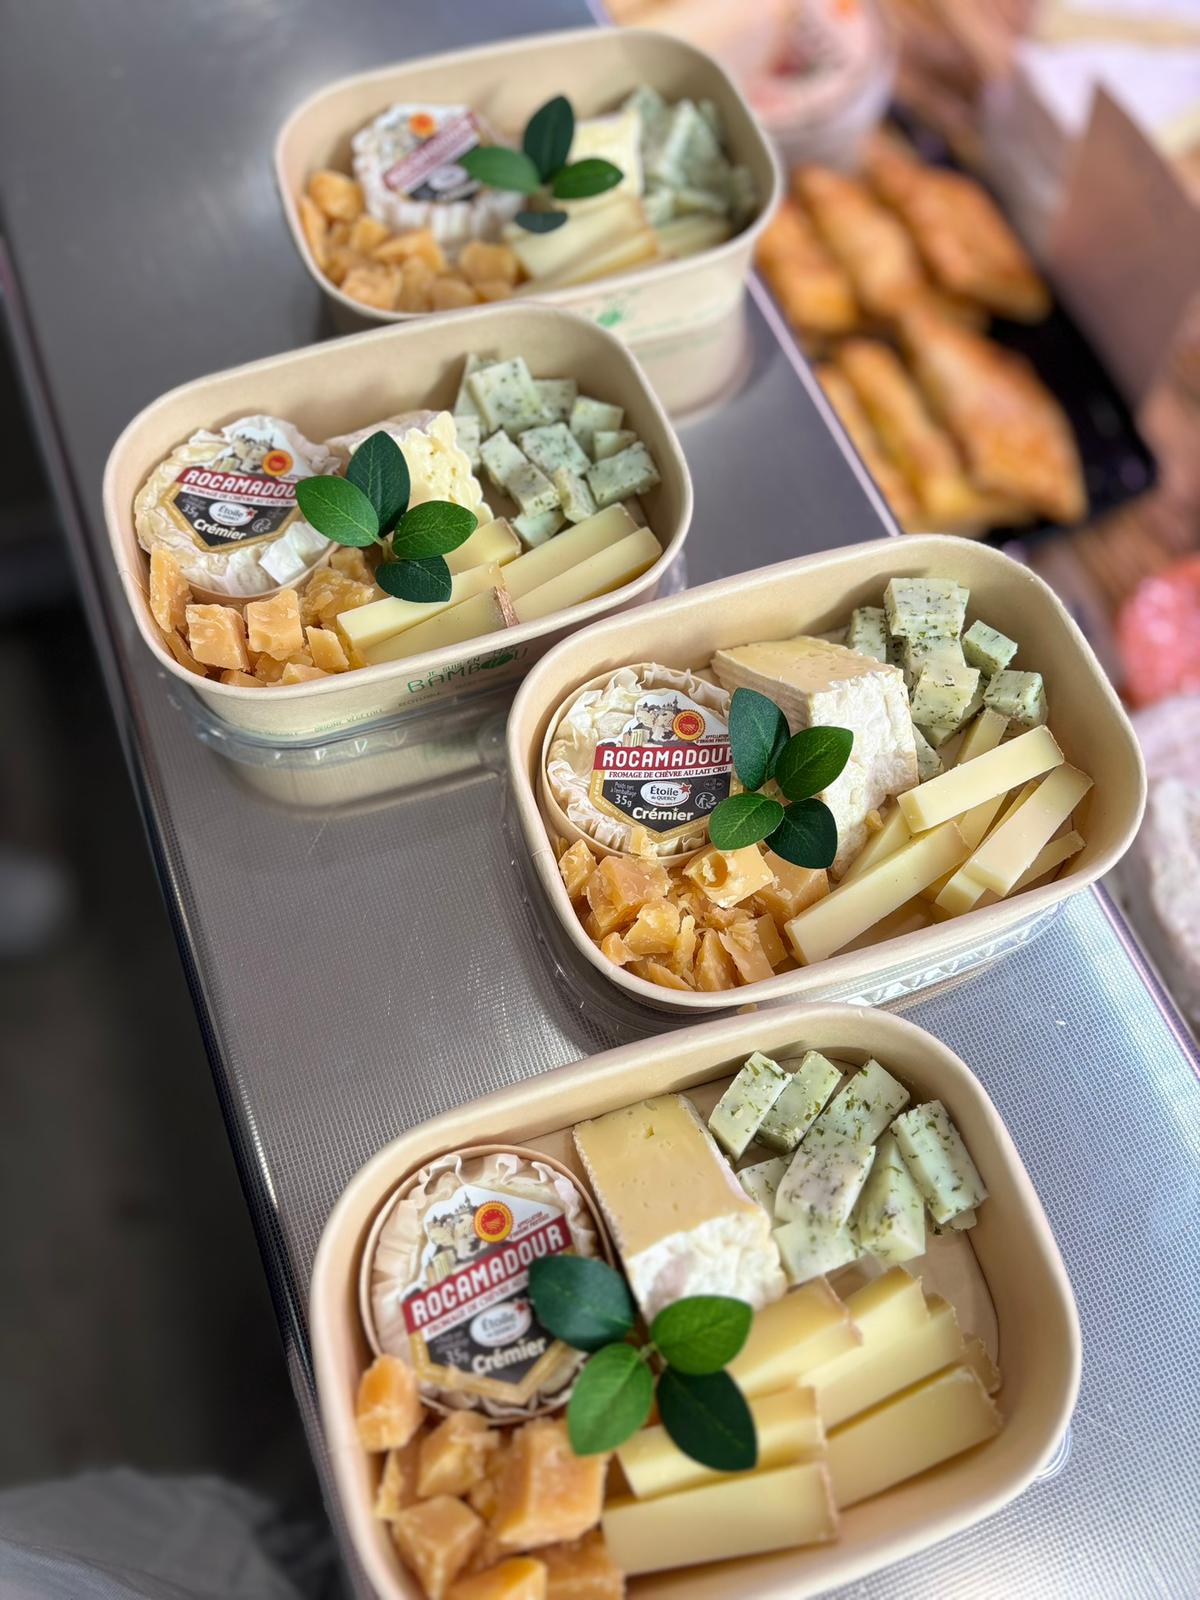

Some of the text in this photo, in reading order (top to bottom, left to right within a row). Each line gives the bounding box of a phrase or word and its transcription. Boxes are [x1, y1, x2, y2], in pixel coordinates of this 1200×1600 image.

[184, 470, 296, 497] ROCAMADOU
[193, 519, 247, 540] Crémier
[407, 647, 529, 693] BAMBU
[655, 769, 681, 778] CHÈVRE
[683, 769, 695, 777] AU
[695, 767, 711, 775] LAIT
[712, 765, 728, 773] CRU
[650, 785, 679, 796] Étoile
[632, 806, 695, 821] Crémier
[410, 1223, 564, 1328] ROCAMADOUR
[472, 1337, 546, 1375] Crémier
